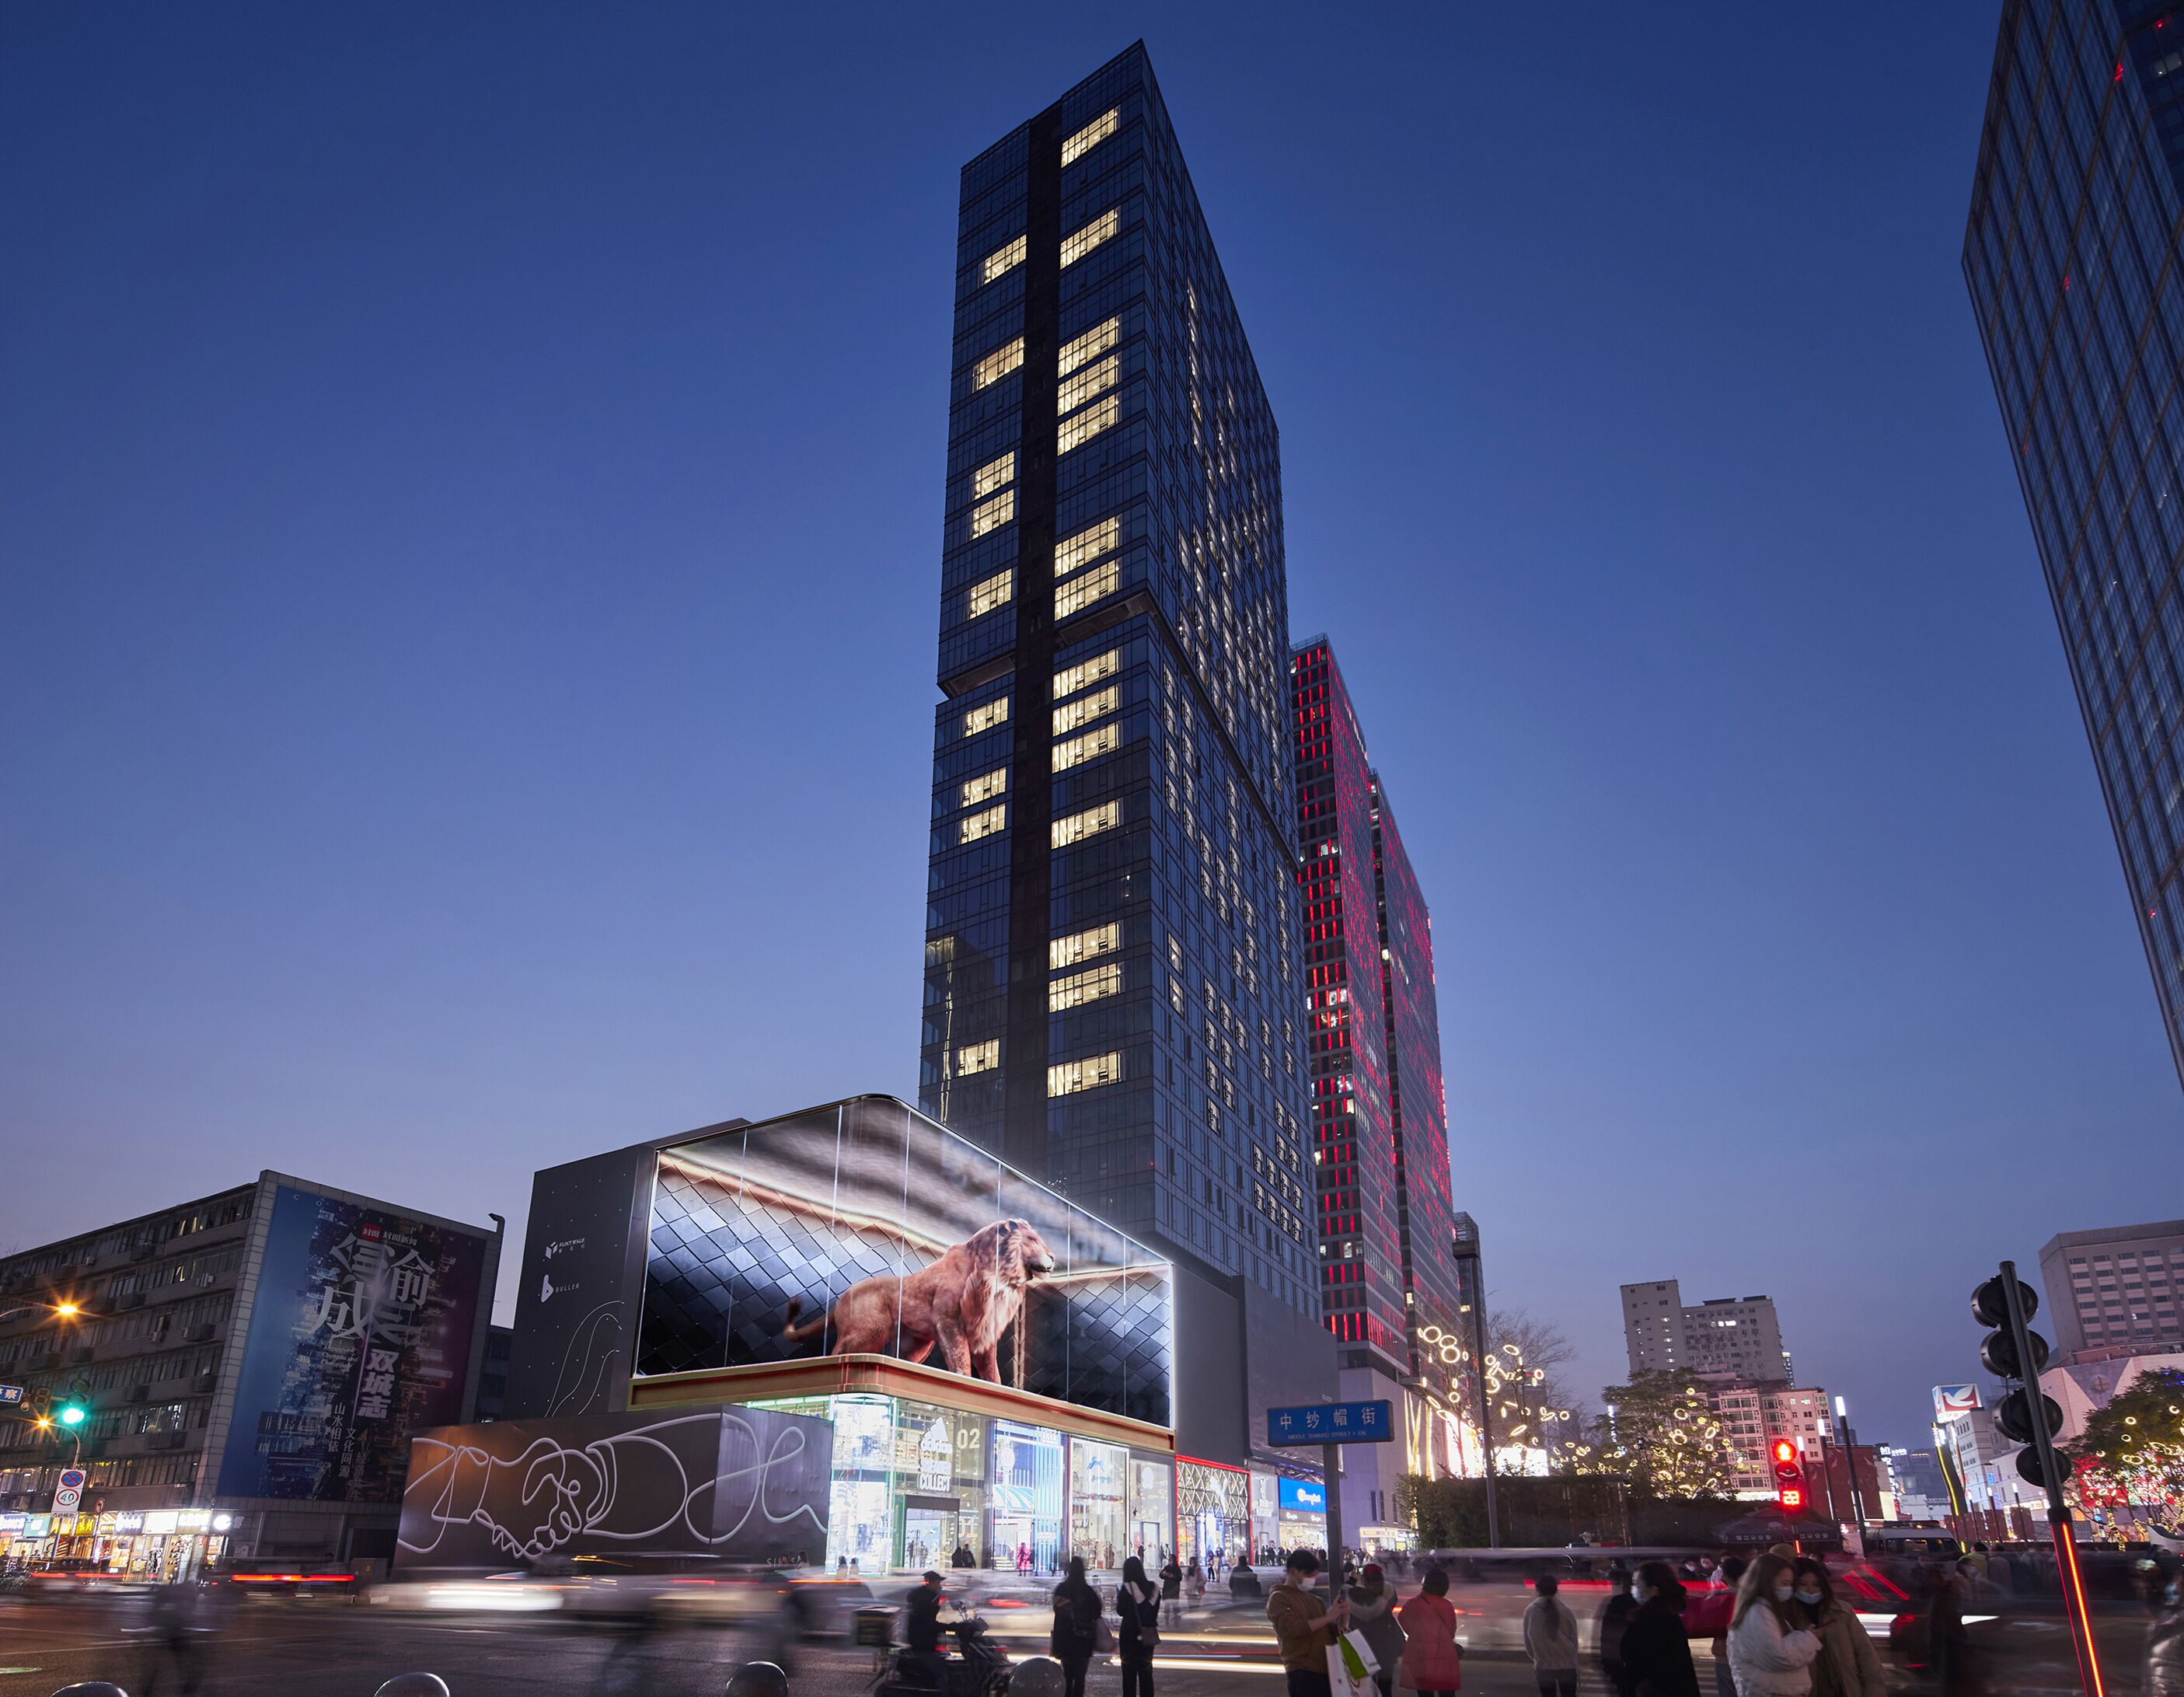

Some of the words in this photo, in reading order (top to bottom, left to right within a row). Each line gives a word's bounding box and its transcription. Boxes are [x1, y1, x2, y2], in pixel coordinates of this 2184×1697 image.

[556, 1283, 580, 1293] BULLER
[327, 1402, 346, 1453] 山水相依
[1280, 1406, 1376, 1431] 中纱帽街
[957, 1427, 981, 1450] 02
[339, 1427, 357, 1478] 文化同源
[919, 1474, 951, 1492] COLLECT
[61, 1493, 75, 1502] 40
